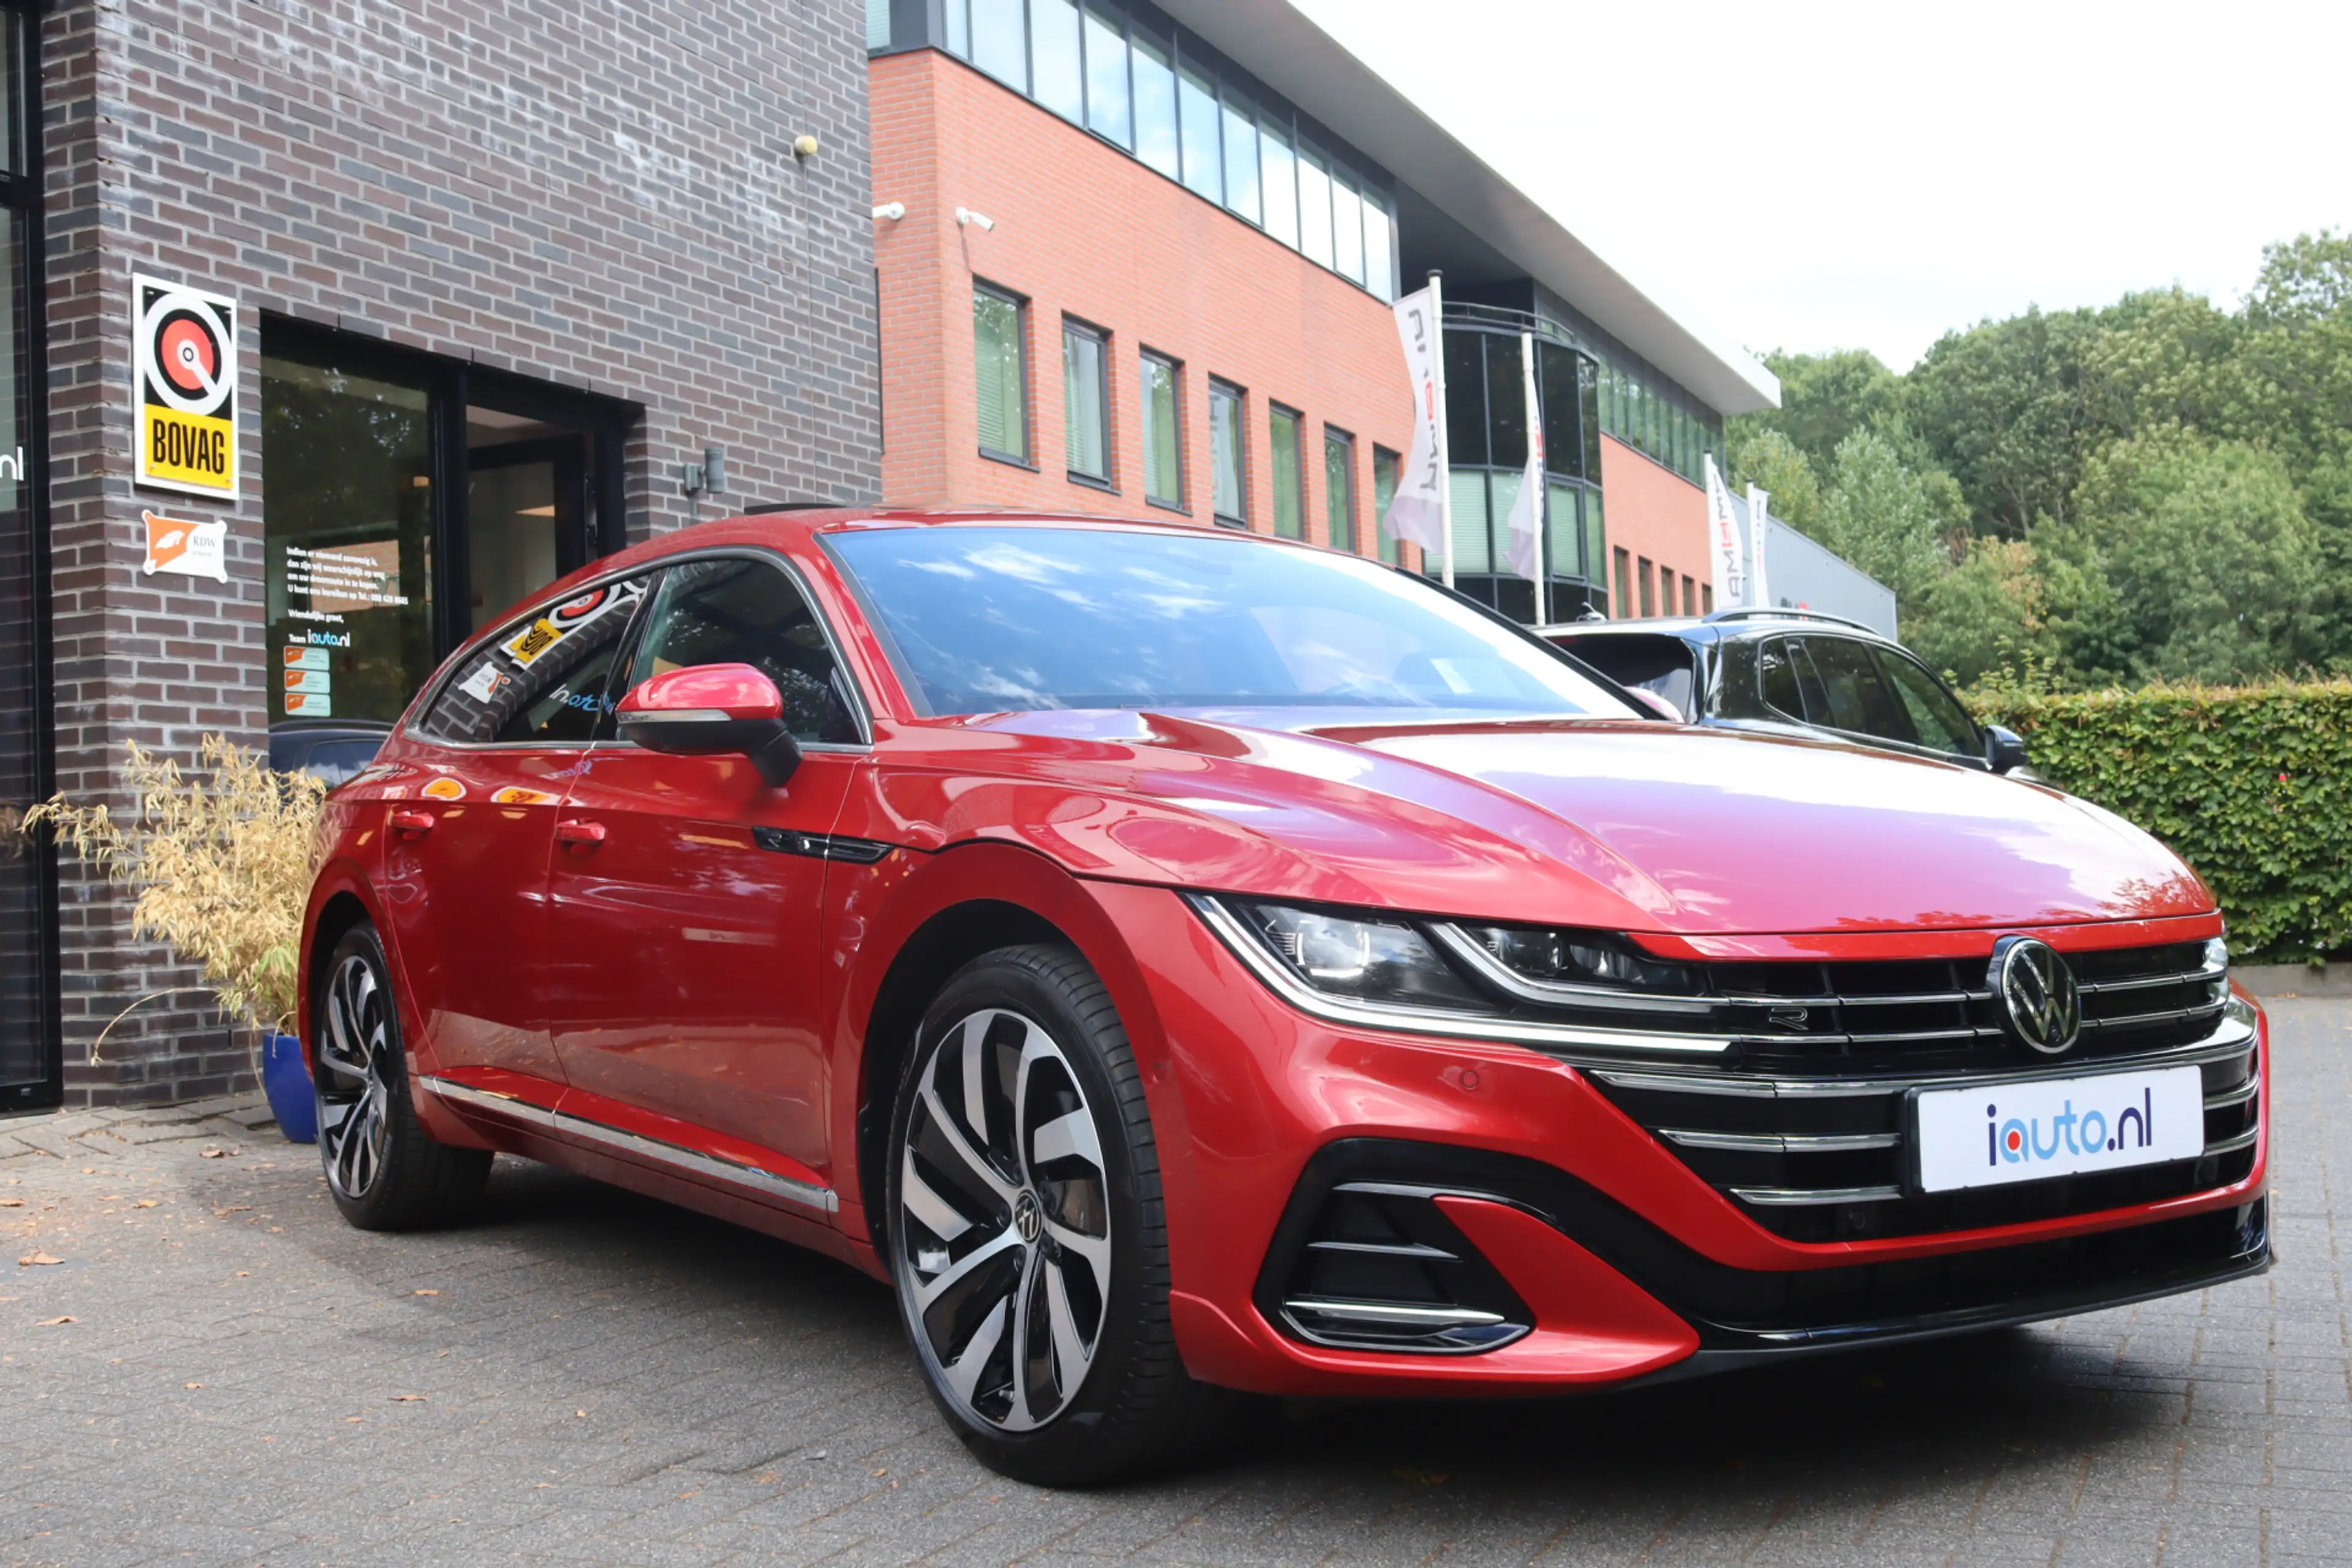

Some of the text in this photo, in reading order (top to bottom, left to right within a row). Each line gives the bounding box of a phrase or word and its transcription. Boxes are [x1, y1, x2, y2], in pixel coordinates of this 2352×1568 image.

[152, 418, 225, 475] BOVAG
[193, 535, 216, 549] RDW
[287, 584, 293, 593] U
[288, 628, 350, 647] Team iauto.nl
[1986, 1087, 2152, 1166] iauto.nl
